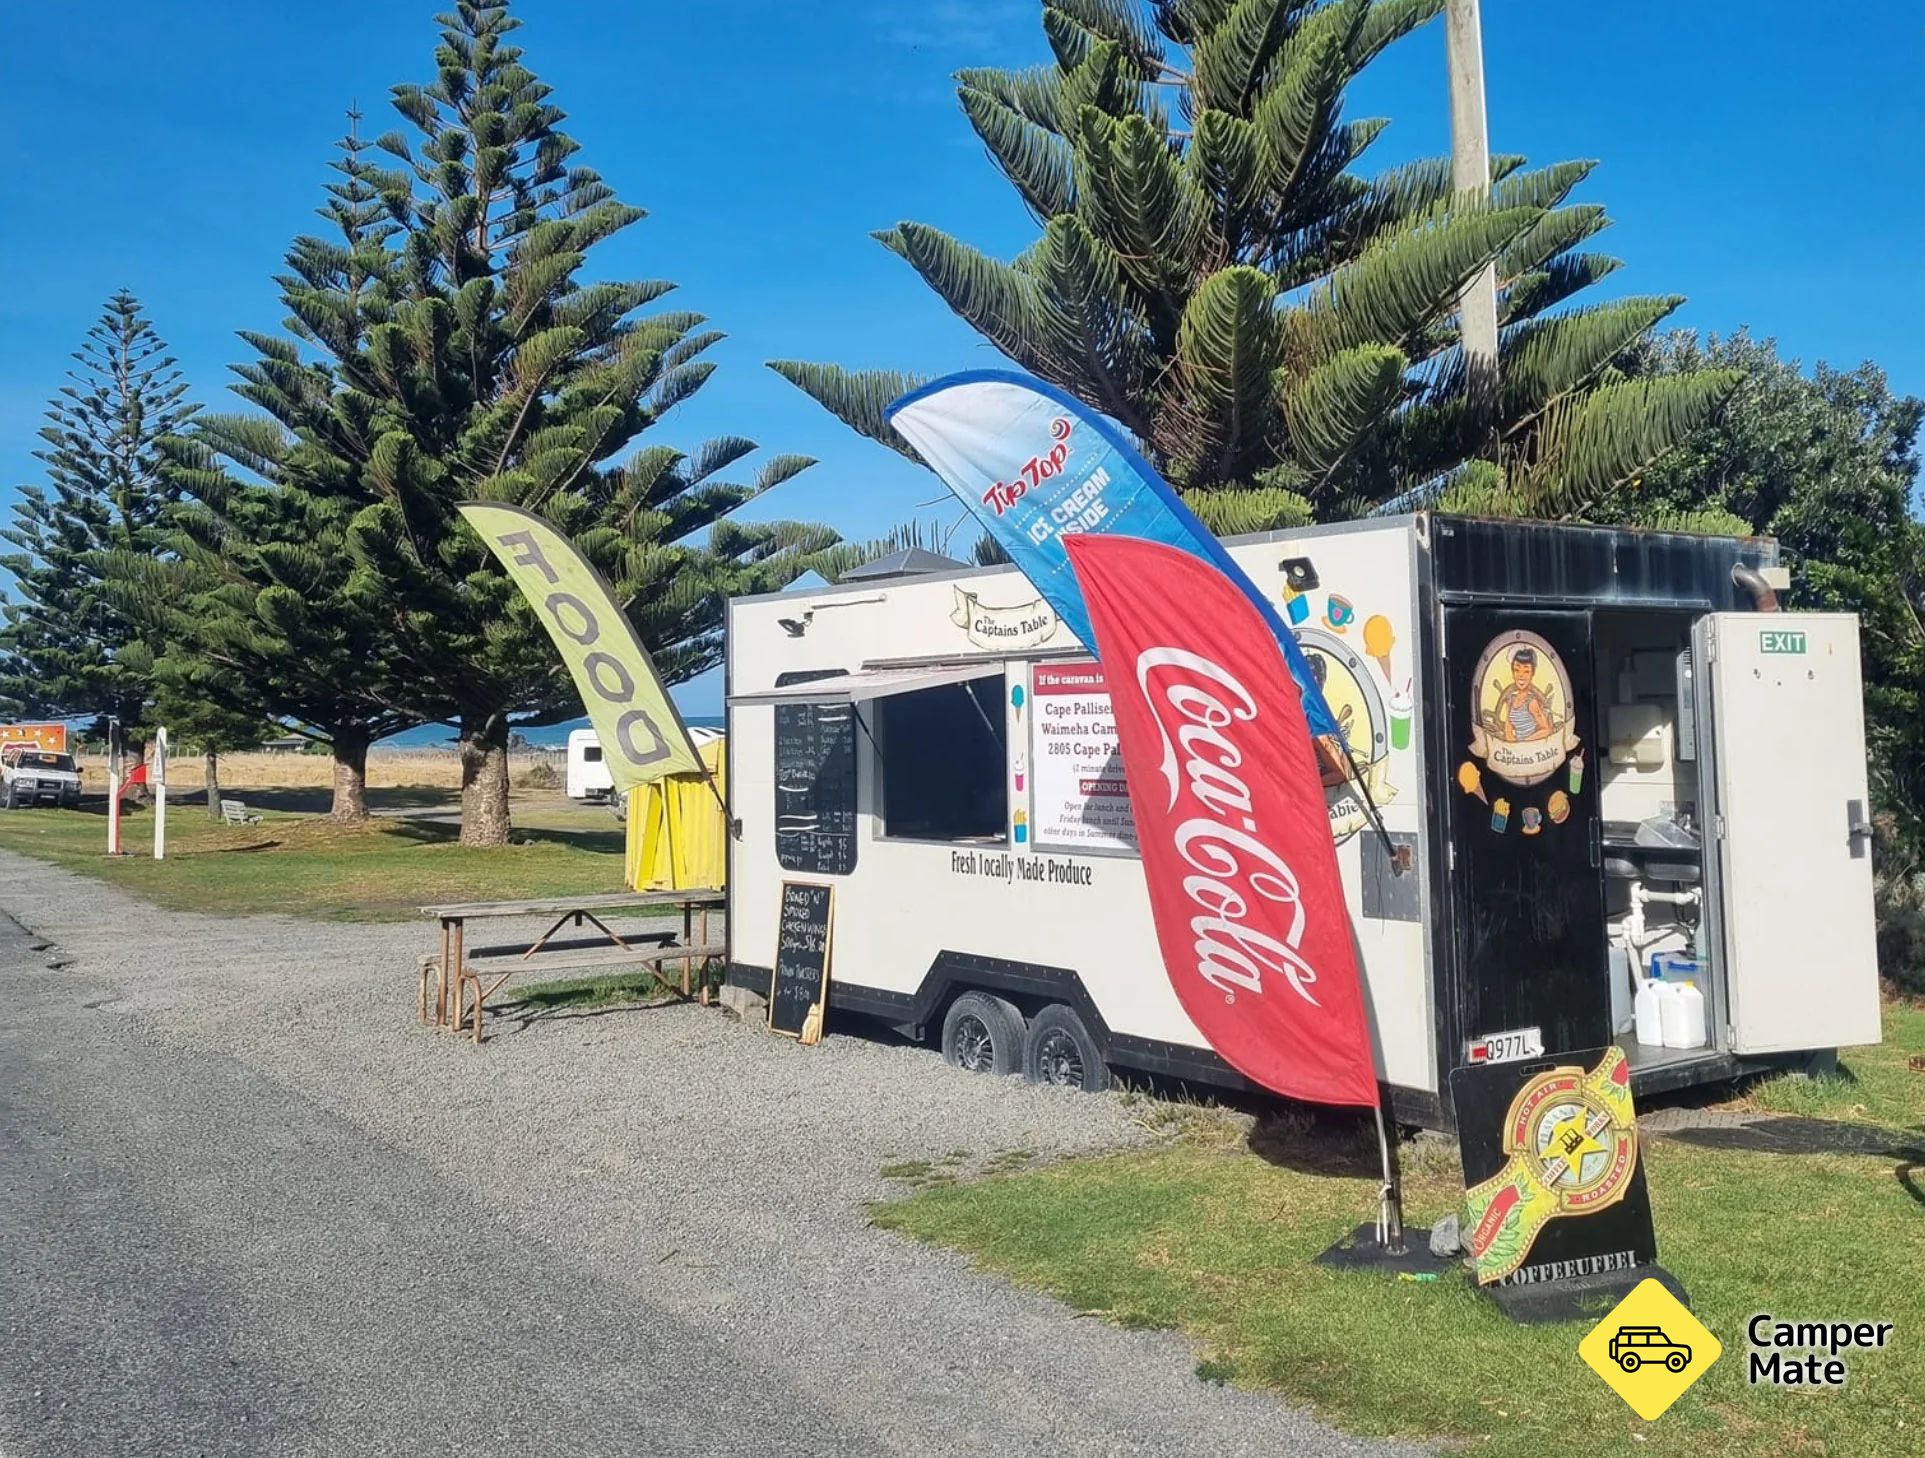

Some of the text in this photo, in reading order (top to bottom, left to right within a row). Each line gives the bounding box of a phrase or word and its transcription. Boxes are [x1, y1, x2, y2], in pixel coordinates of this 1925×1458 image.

[982, 443, 1068, 516] Tip Top
[1027, 466, 1111, 546] ICE CREAM
[975, 615, 1048, 637] Captains Table
[983, 615, 995, 625] The
[1761, 633, 1804, 651] EXIT
[1047, 674, 1059, 685] the
[1061, 675, 1095, 684] caravan
[1096, 672, 1104, 683] is
[1045, 703, 1071, 718] Cape
[1041, 723, 1089, 735] Waimeha
[1048, 743, 1071, 755] 2805
[1074, 743, 1100, 759] Cape
[1494, 747, 1558, 766] Captains Table
[1082, 782, 1117, 792] OPENING
[1065, 801, 1081, 811] Open
[1328, 800, 1358, 820] able
[1059, 814, 1080, 825] Friday
[1136, 646, 1321, 1007] Coca-Cola
[1062, 828, 1077, 839] days
[951, 851, 976, 875] Fresh
[1017, 856, 1044, 881] Made
[1048, 858, 1092, 885] Produce
[1486, 1035, 1530, 1060] Q977L
[1520, 1083, 1557, 1125] HOT AIR
[1581, 1153, 1625, 1202] ROASTED
[1475, 1207, 1501, 1250] ORGANIC
